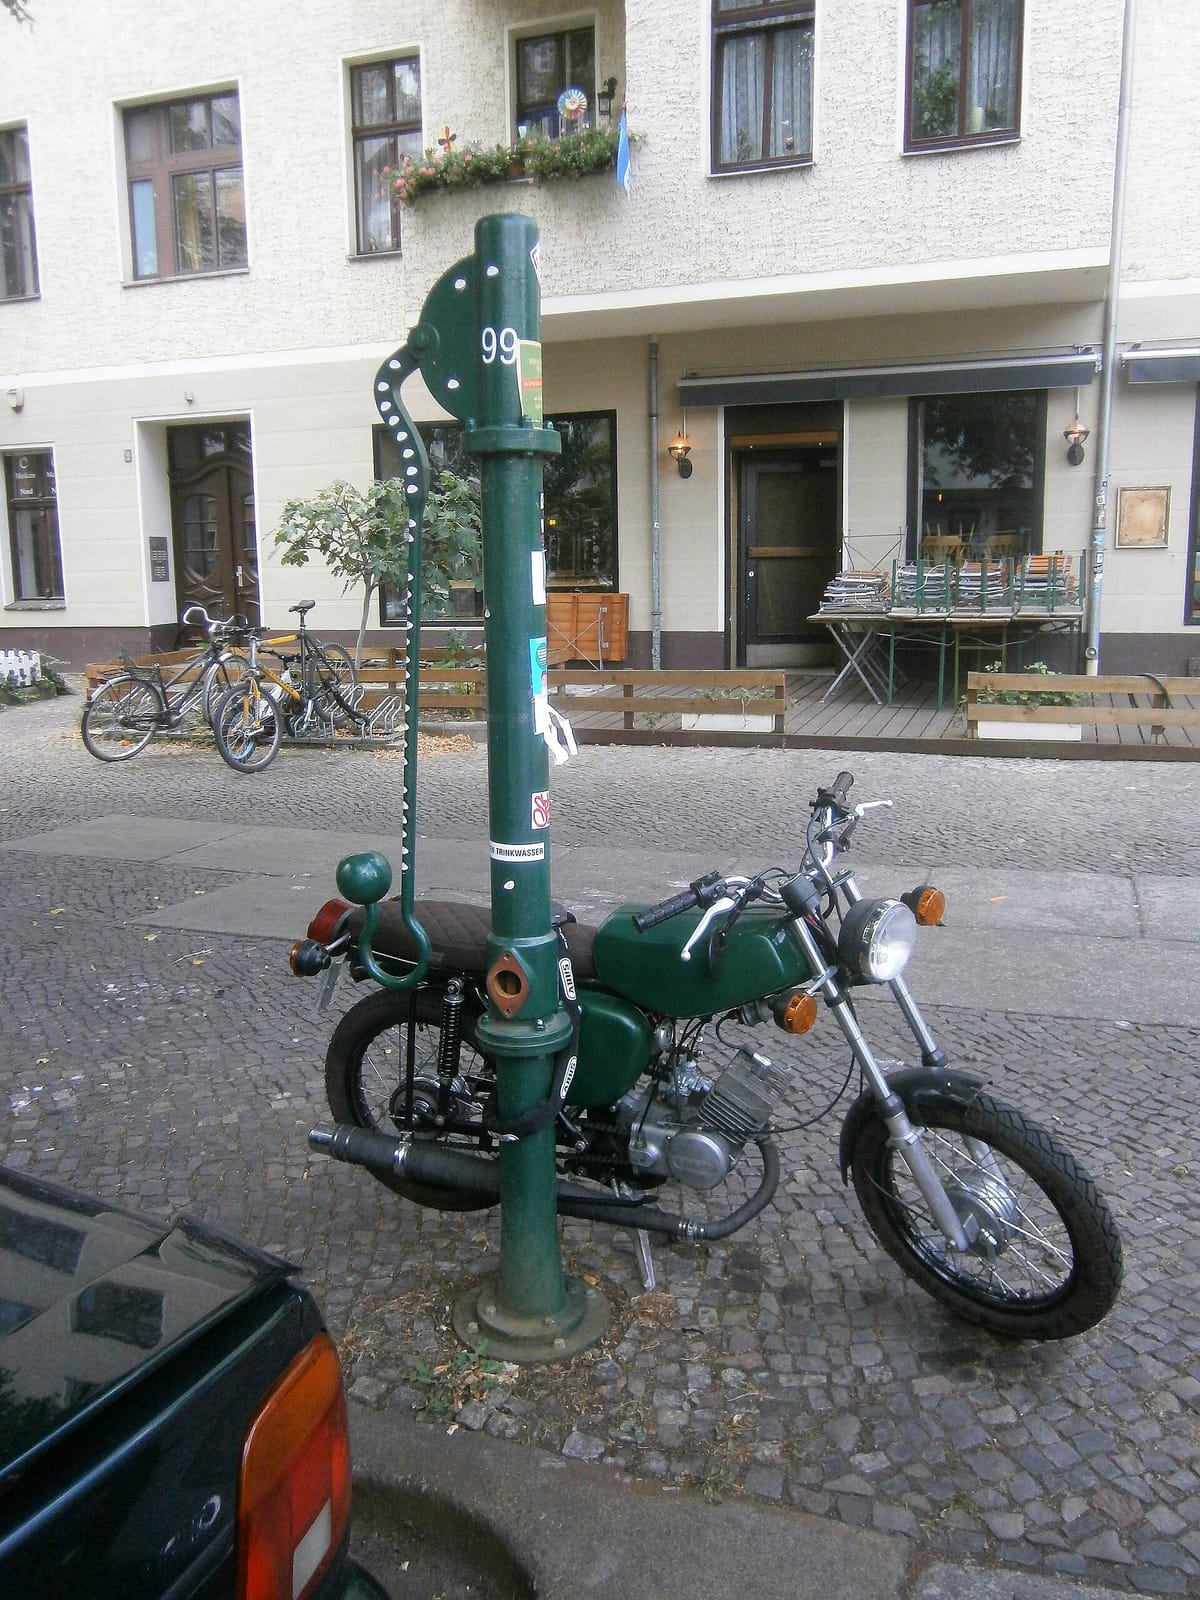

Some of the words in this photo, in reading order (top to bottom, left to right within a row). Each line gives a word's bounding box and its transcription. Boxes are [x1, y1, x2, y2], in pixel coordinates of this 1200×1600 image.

[482, 327, 518, 364] 99
[496, 847, 544, 857] TRINKWASSER
[562, 964, 574, 993] ABUS
[564, 1062, 576, 1092] ABUS
